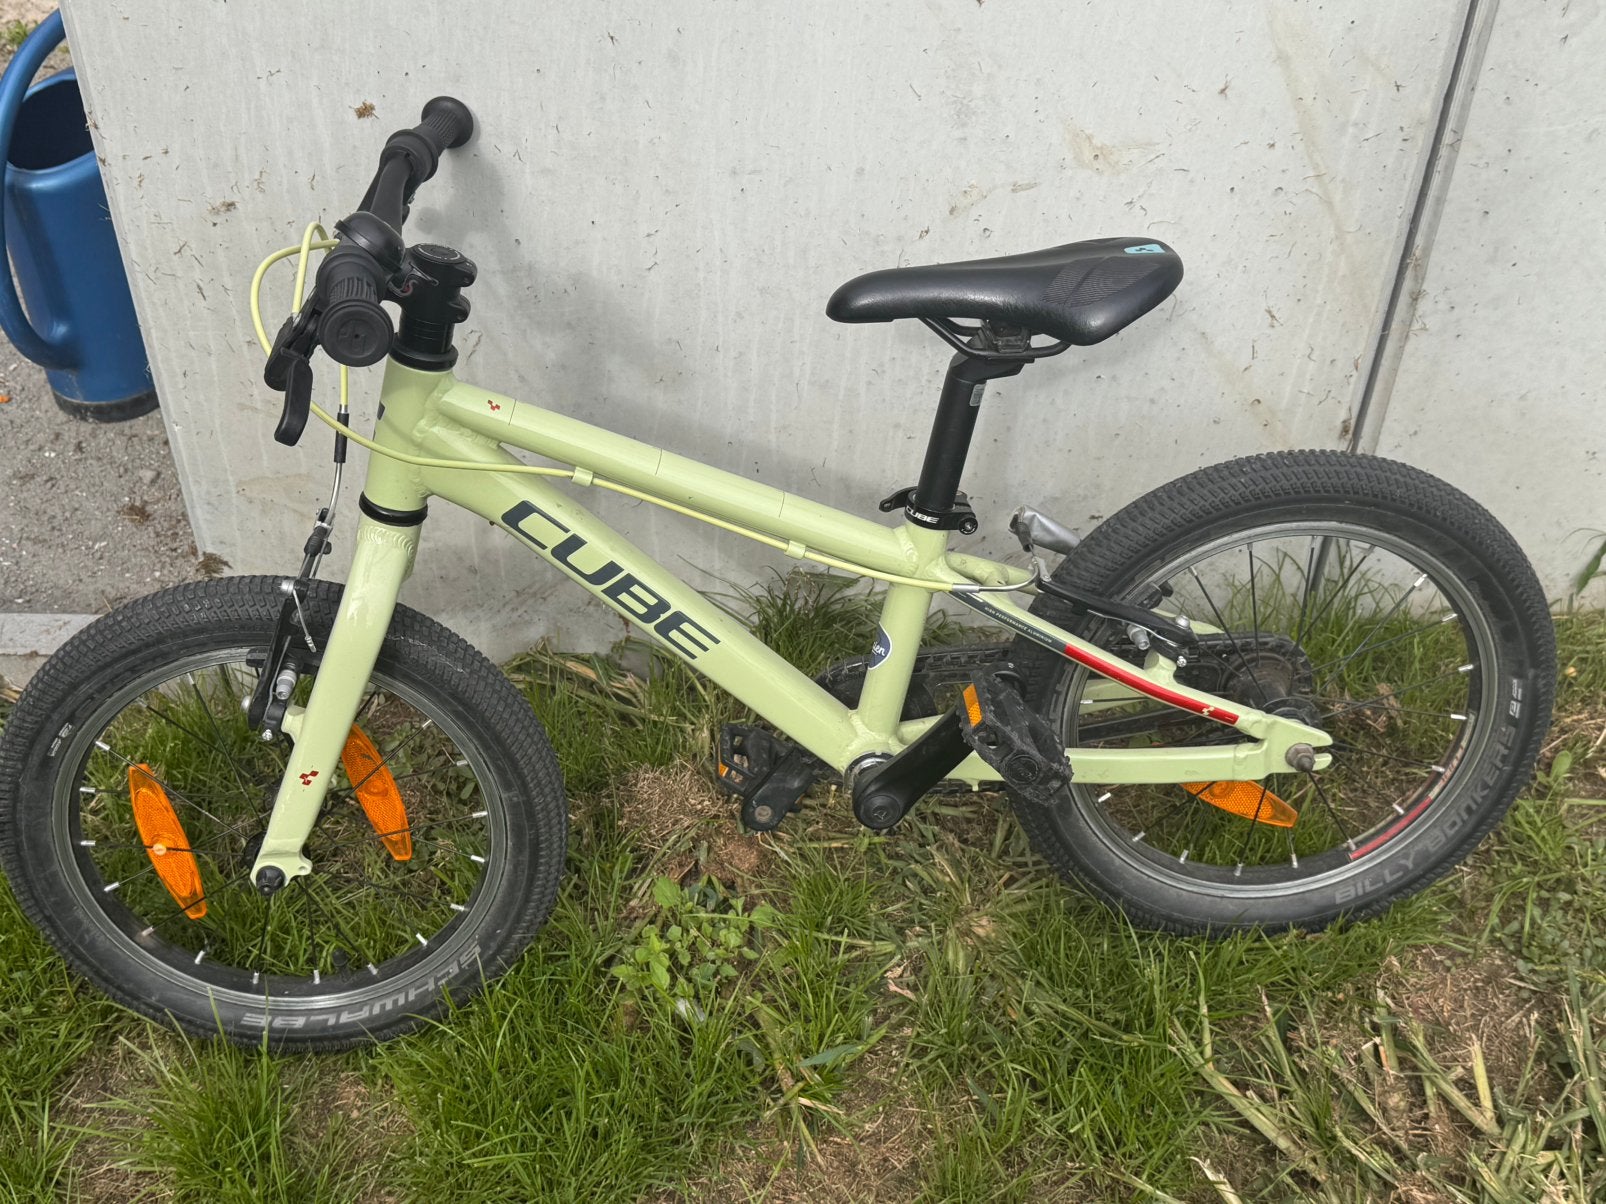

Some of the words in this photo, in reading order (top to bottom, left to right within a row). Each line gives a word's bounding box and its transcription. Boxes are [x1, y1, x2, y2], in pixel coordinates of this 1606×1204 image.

[905, 505, 940, 524] CUBE
[501, 500, 721, 660] CUBE
[1335, 852, 1415, 905] BILLY
[1429, 725, 1517, 852] BONKERS
[240, 939, 481, 1028] SCHWALBE
